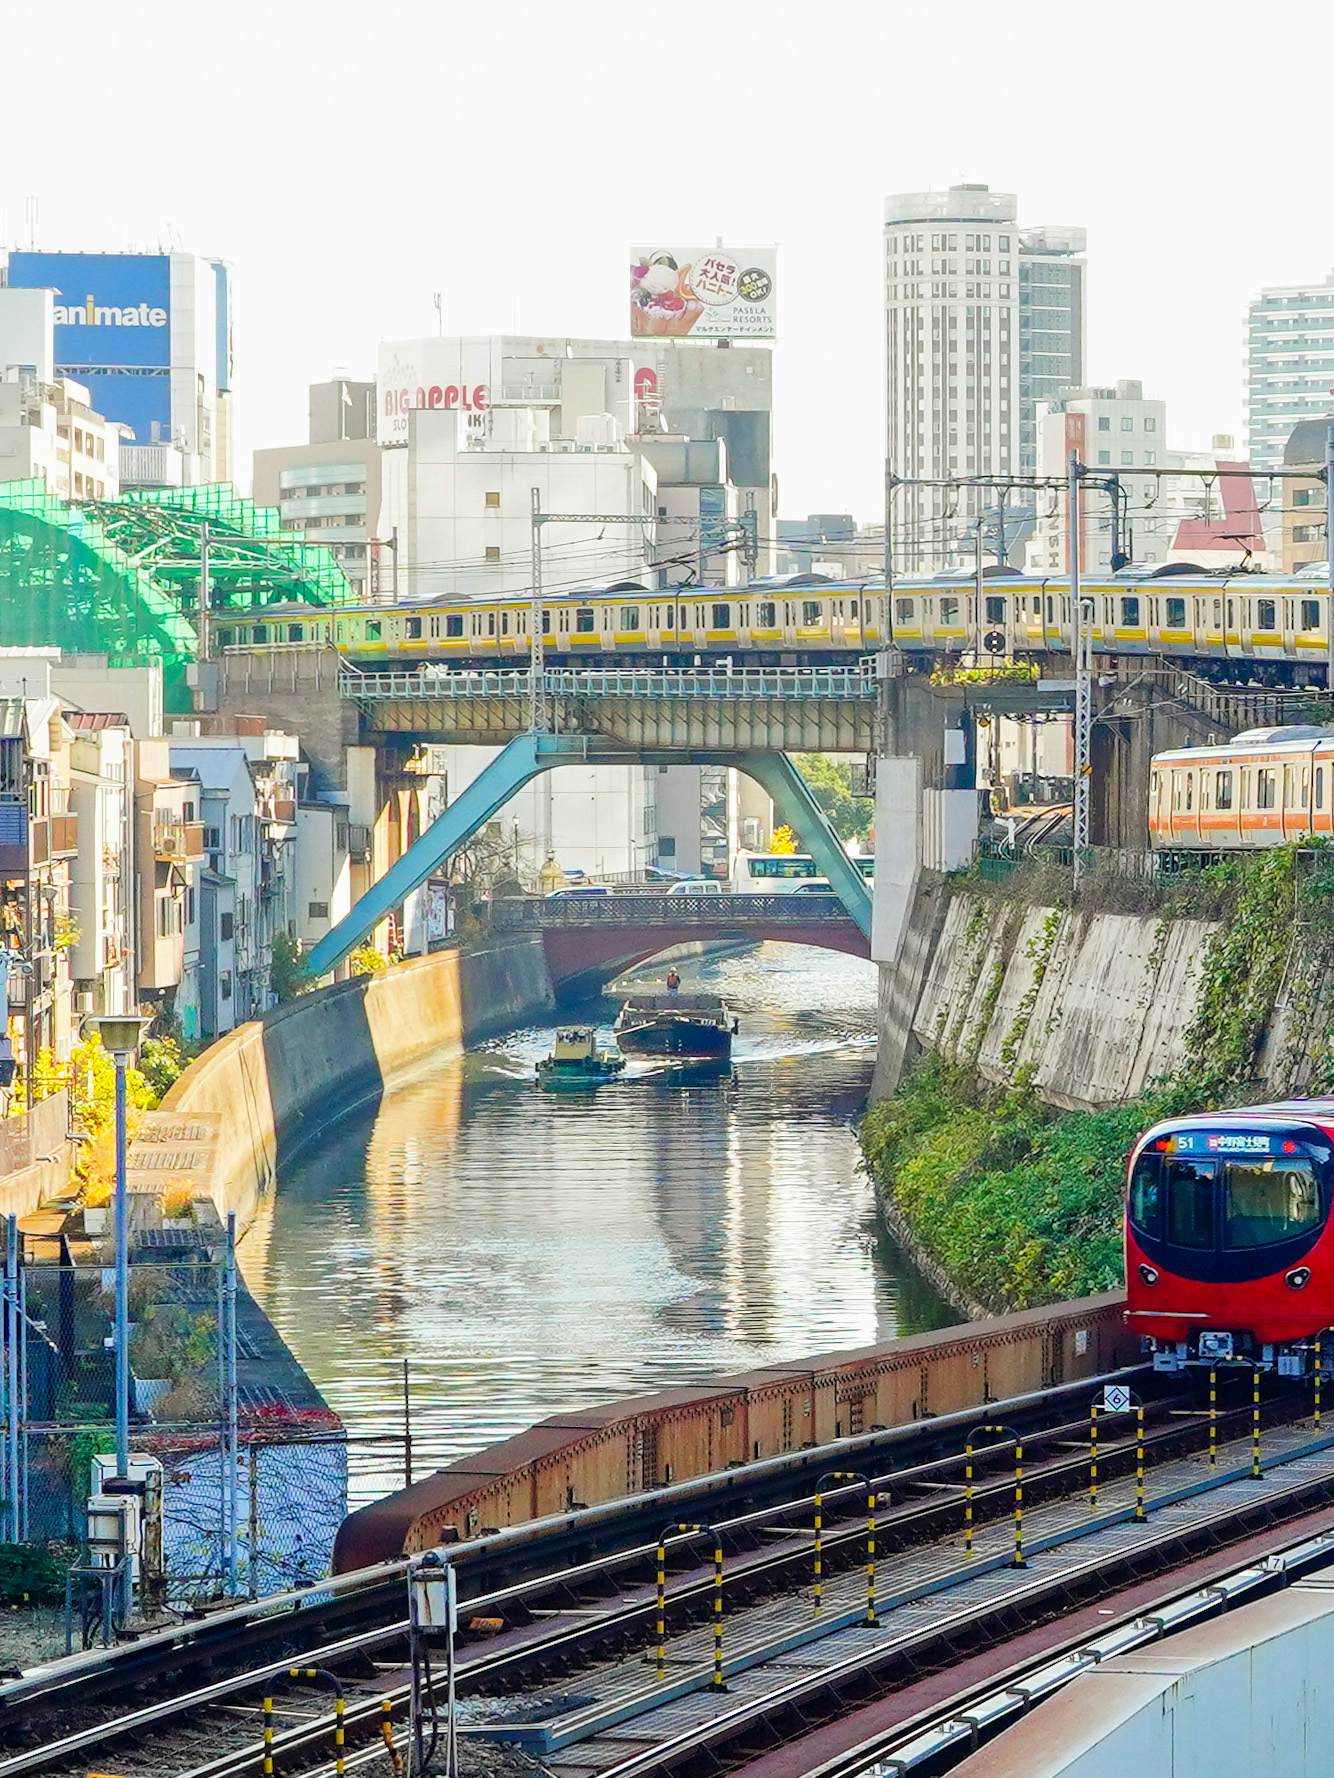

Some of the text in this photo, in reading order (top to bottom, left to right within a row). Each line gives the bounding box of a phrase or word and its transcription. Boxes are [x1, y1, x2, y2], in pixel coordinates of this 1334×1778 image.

[53, 295, 168, 328] animate
[384, 385, 491, 417] BIG APPLE
[1178, 1136, 1194, 1149] 51
[1113, 1393, 1121, 1404] 6
[1273, 1558, 1280, 1569] 7
